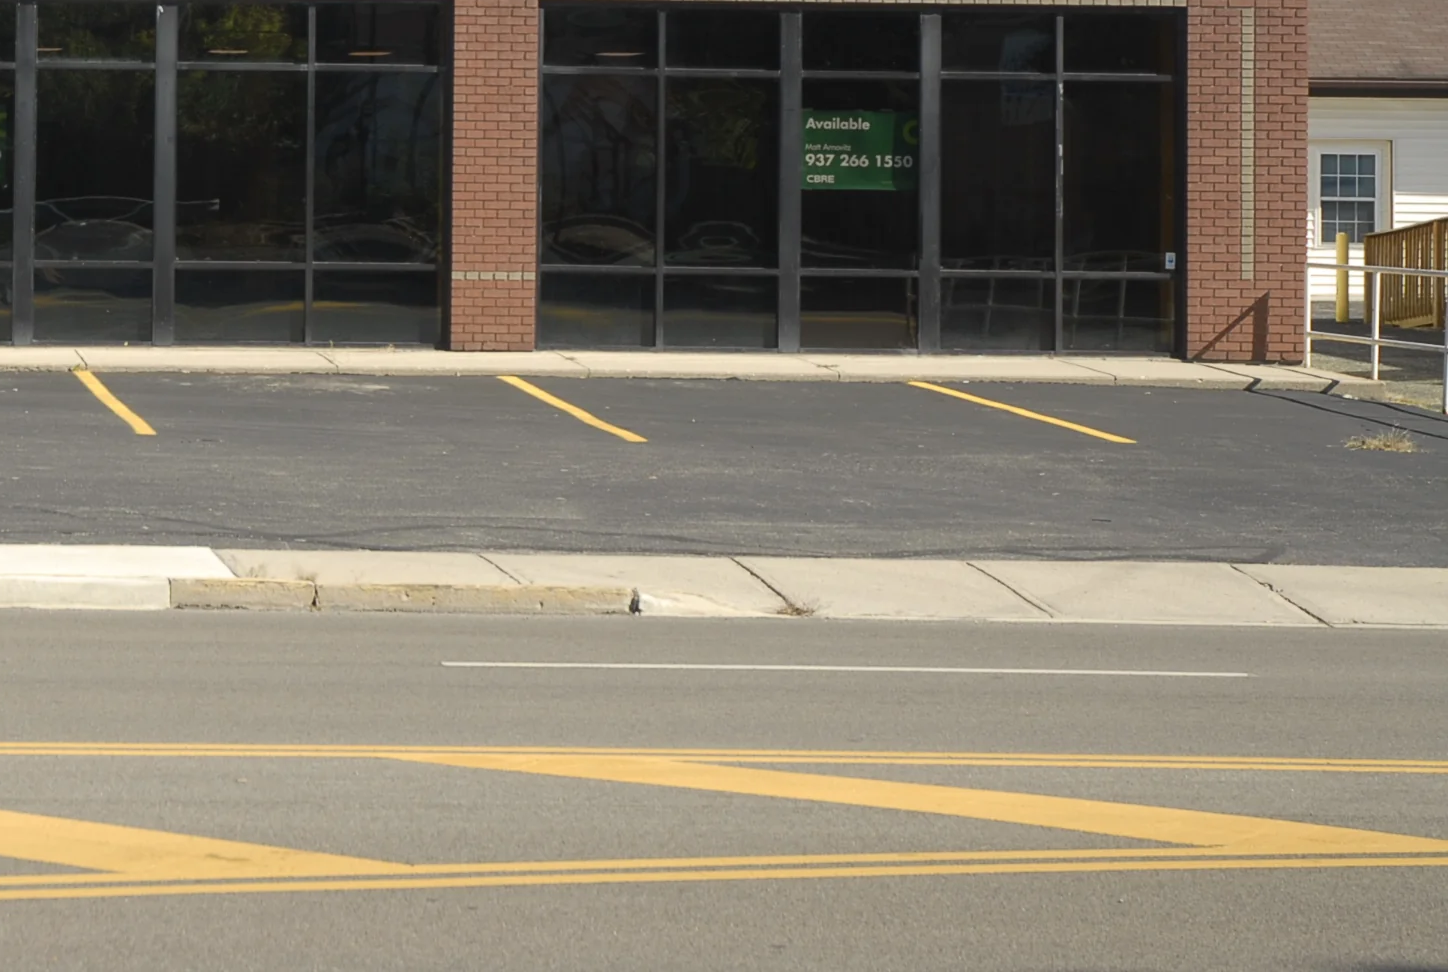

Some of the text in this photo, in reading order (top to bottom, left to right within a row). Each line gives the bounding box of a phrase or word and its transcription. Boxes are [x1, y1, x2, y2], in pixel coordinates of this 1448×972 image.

[805, 117, 871, 130] Available
[805, 154, 913, 168] 937 266 1550
[806, 174, 835, 183] CBRE
